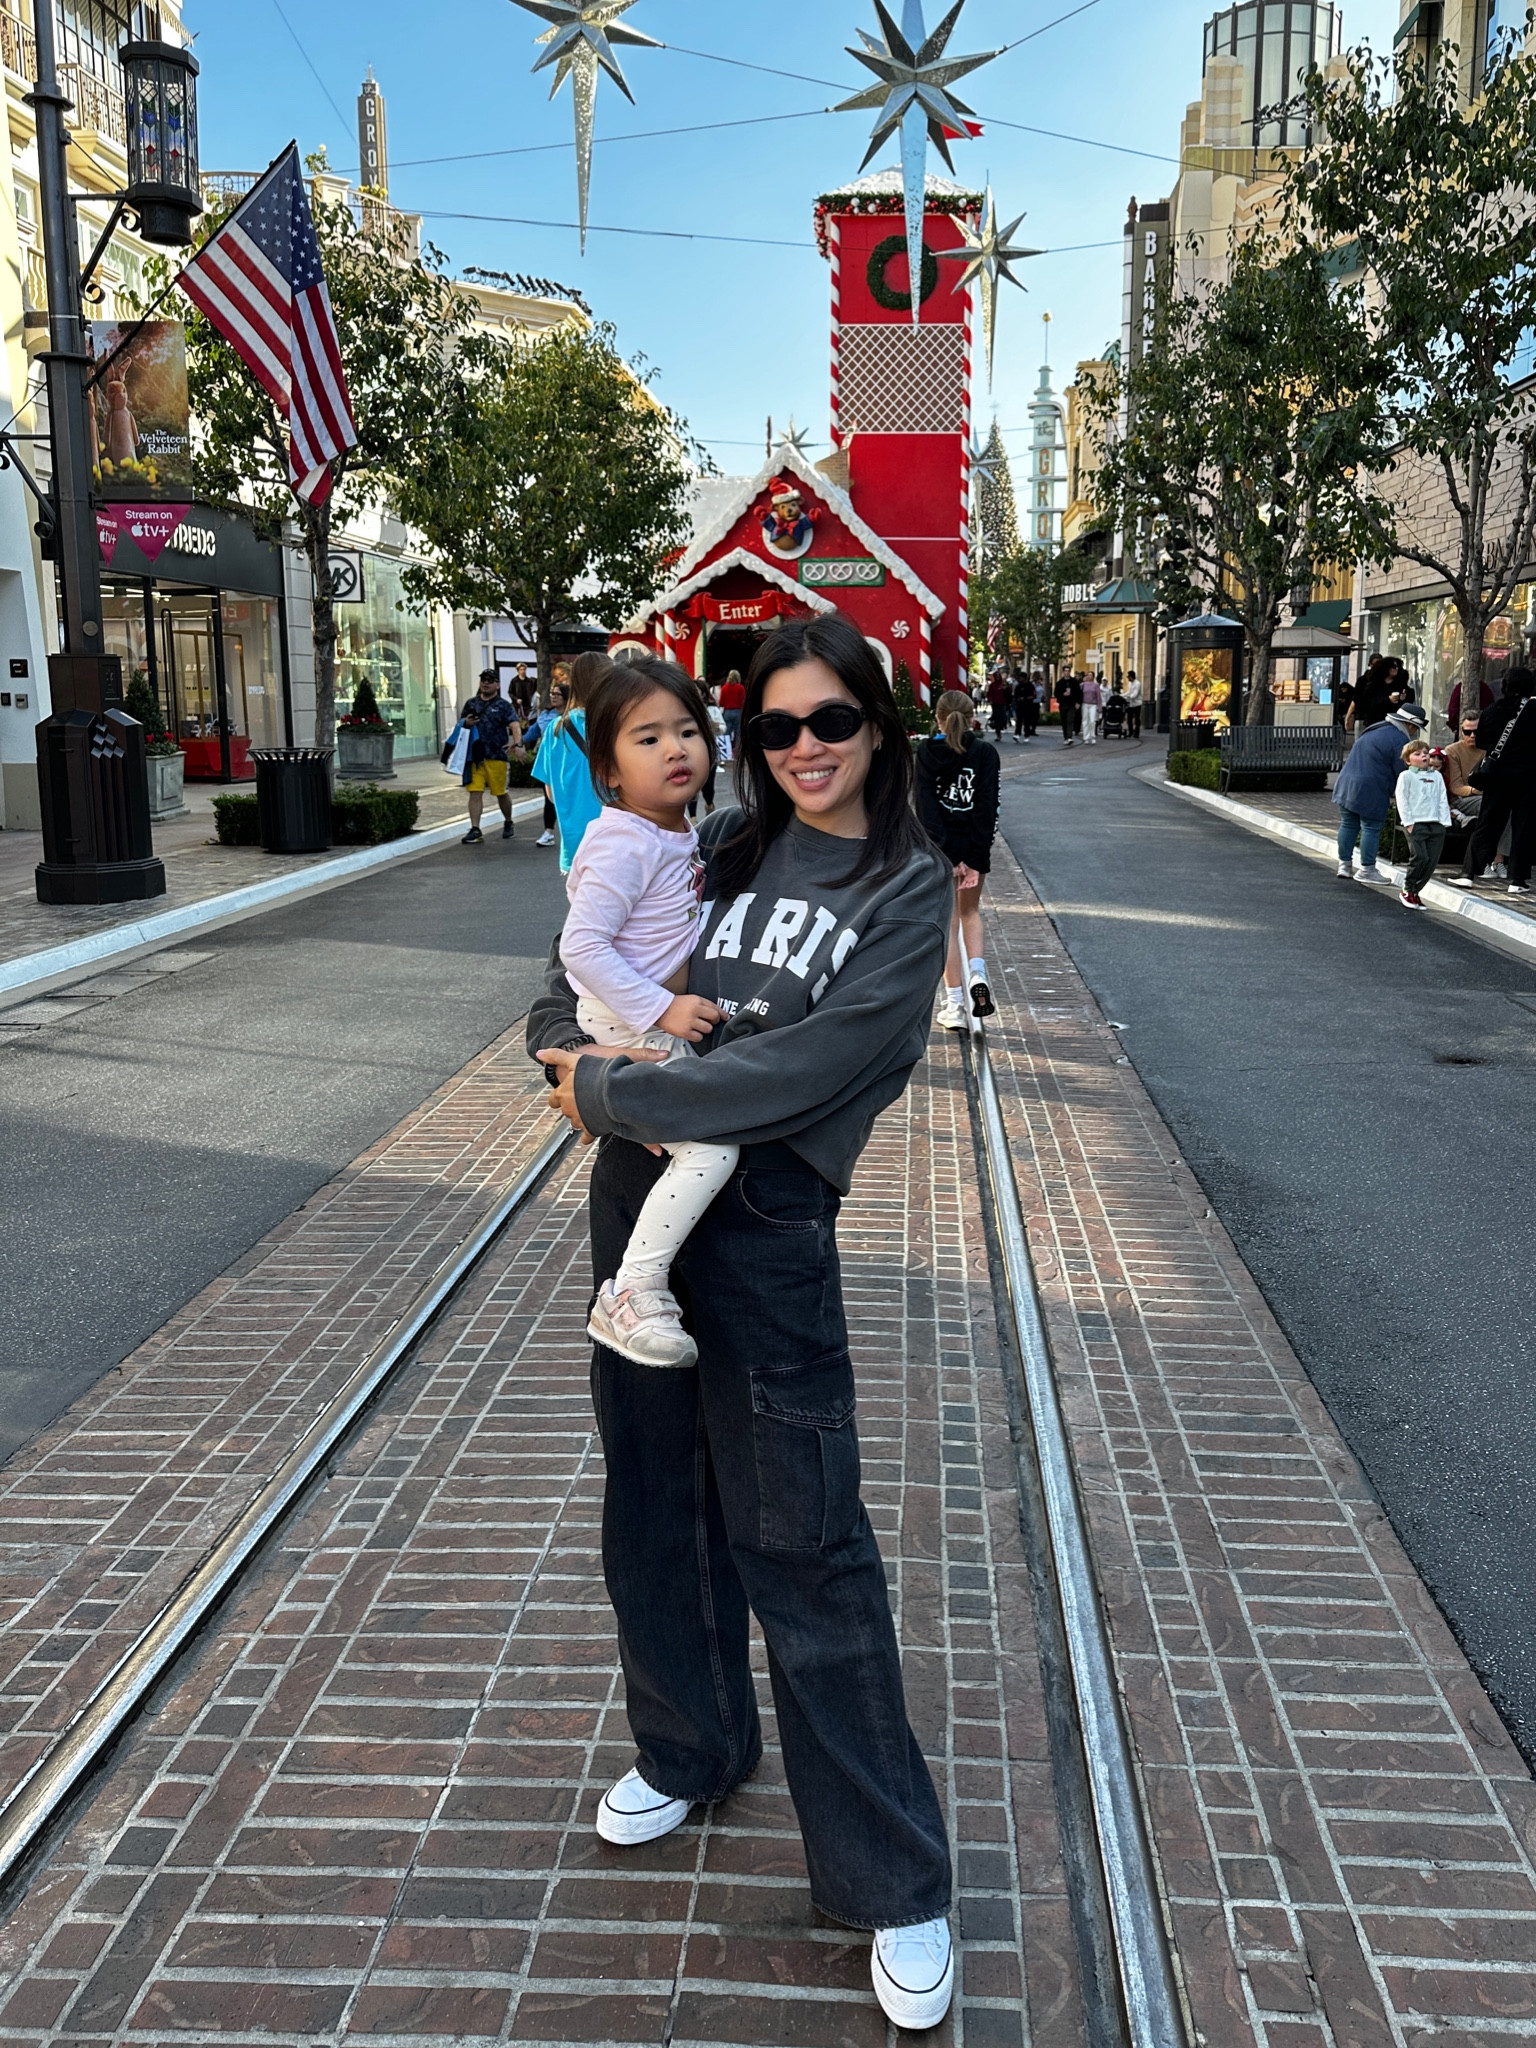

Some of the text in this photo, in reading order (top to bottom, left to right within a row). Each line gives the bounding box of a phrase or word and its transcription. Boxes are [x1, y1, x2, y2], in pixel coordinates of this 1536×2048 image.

[365, 98, 378, 190] GROV
[155, 428, 167, 436] The
[140, 433, 188, 444] Velveteen
[147, 444, 181, 454] Rabbit
[125, 509, 173, 520] Stream on
[144, 523, 170, 537] tv+
[719, 602, 763, 621] Enter
